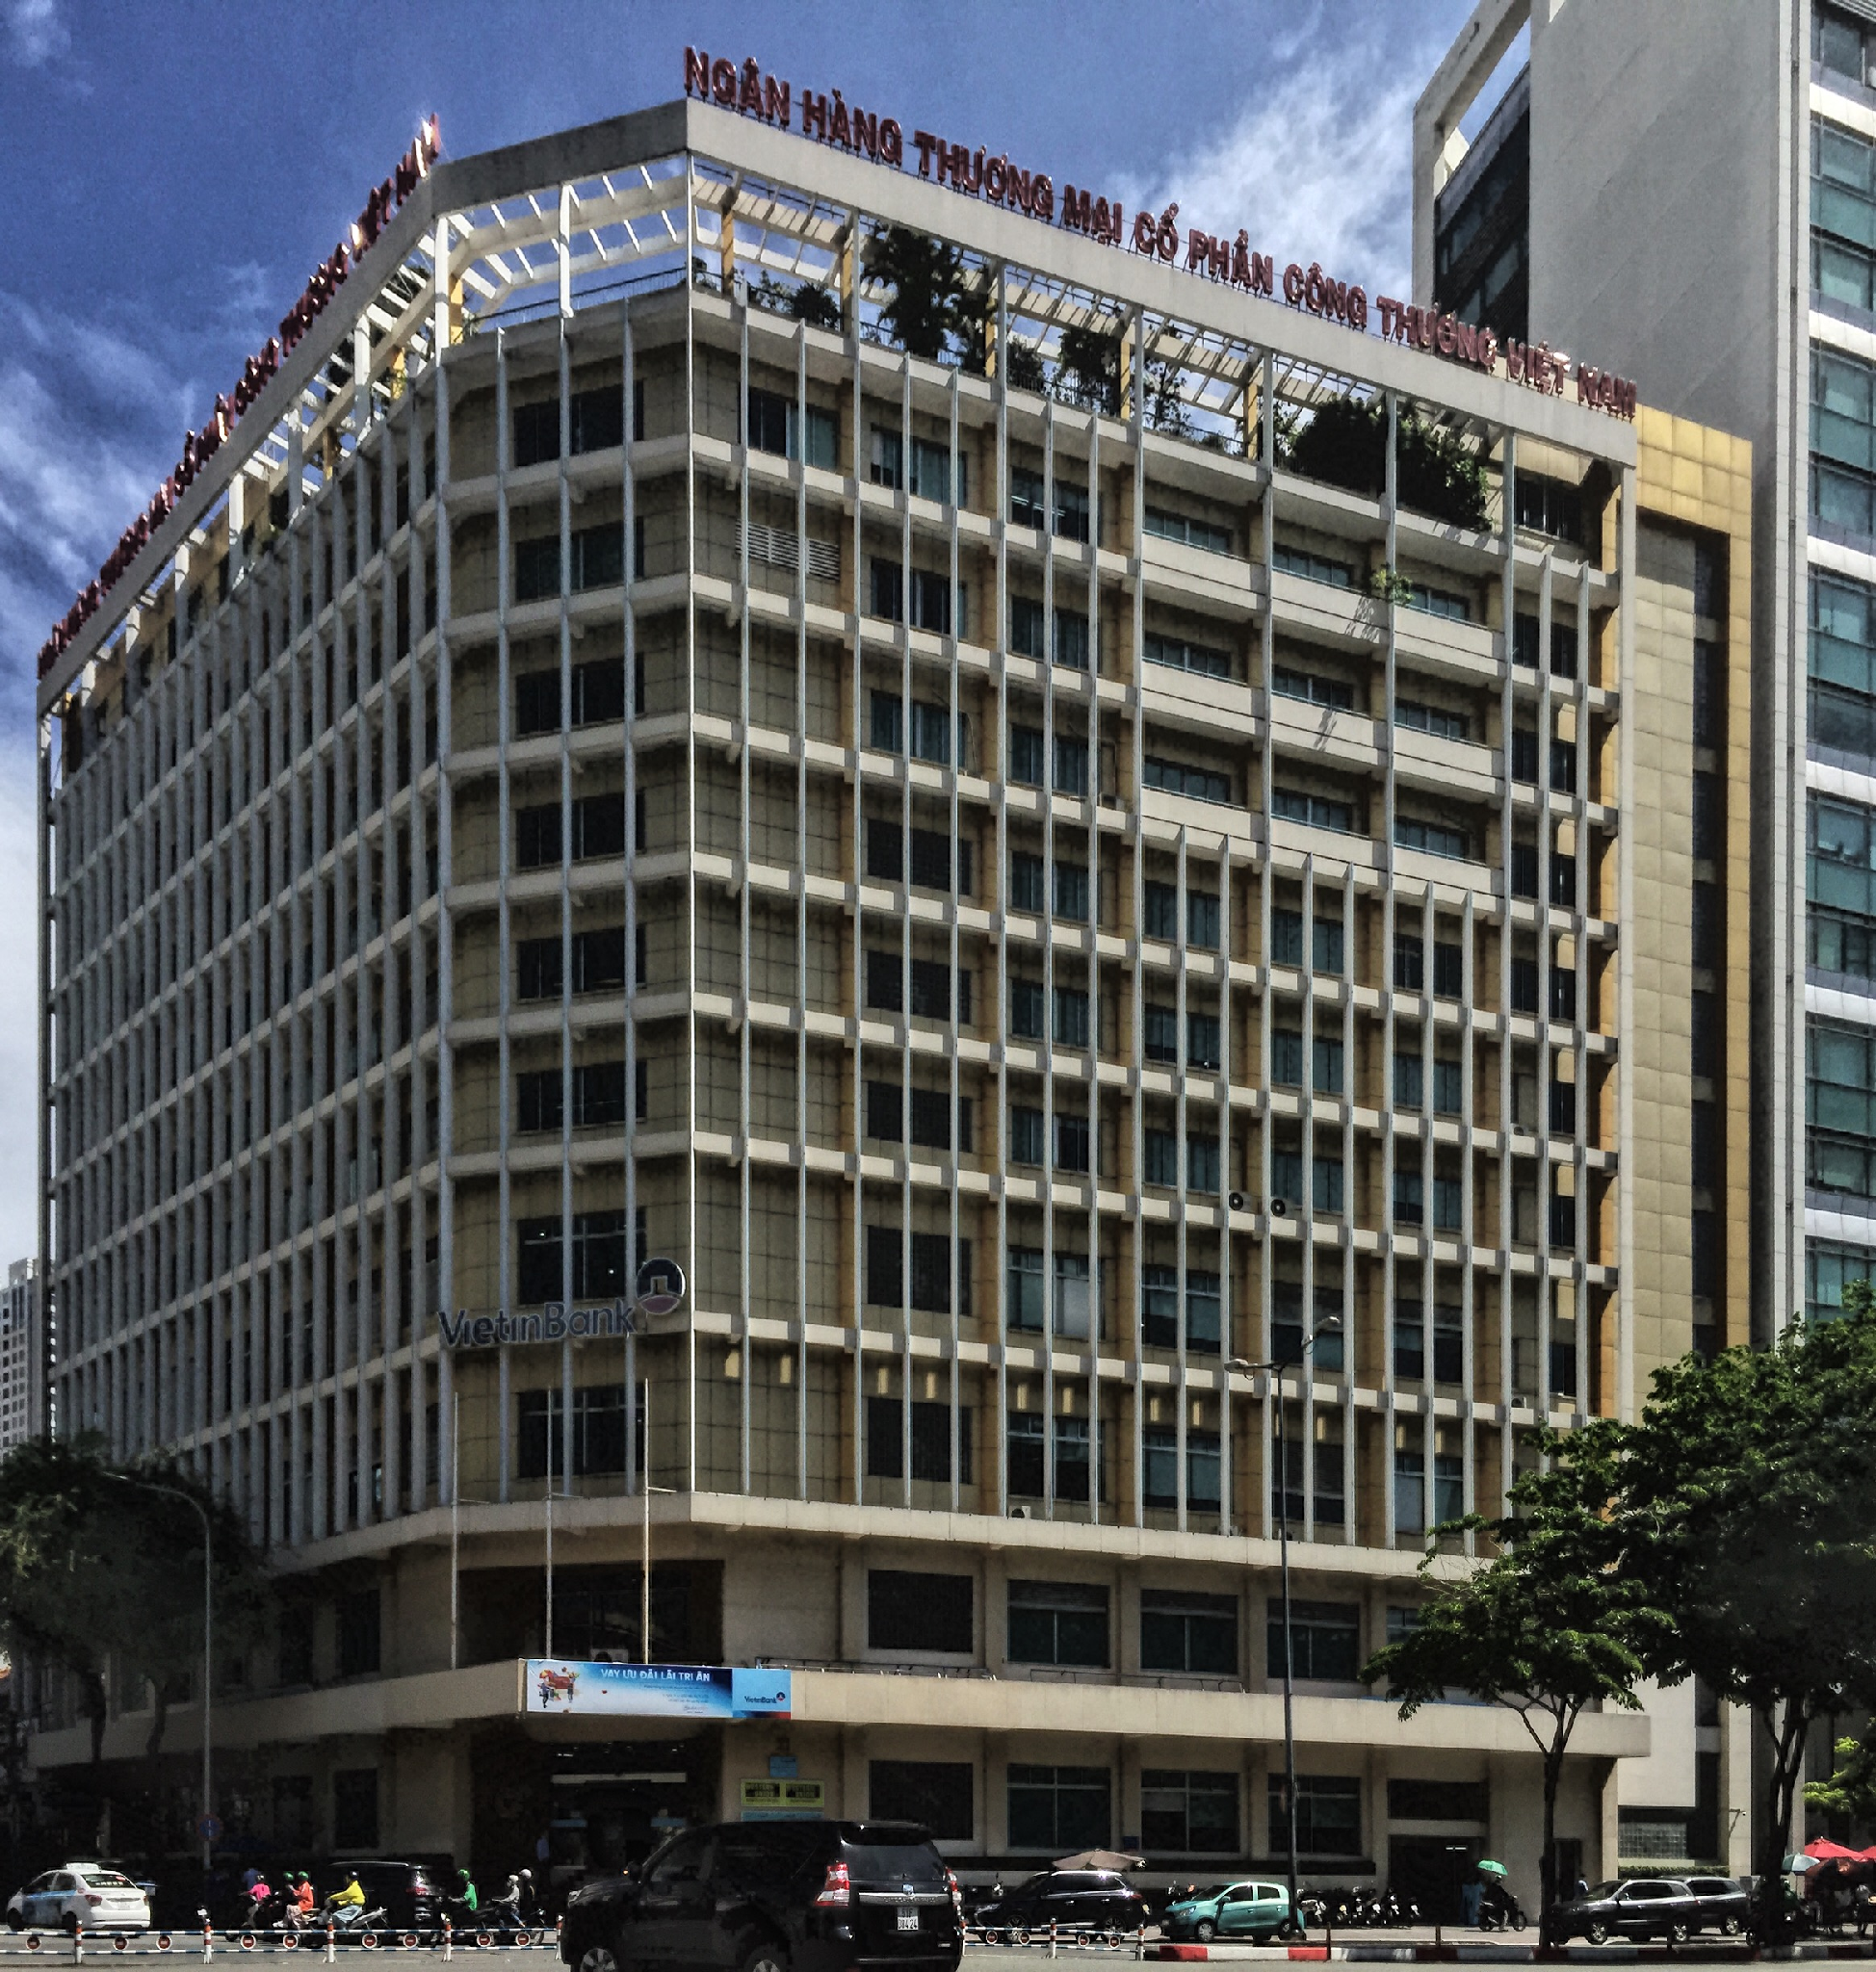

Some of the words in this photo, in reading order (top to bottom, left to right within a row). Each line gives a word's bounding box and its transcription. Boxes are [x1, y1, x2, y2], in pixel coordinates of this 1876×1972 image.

[683, 45, 791, 127] NGÂN
[801, 88, 903, 168] HÀNG
[914, 129, 1055, 221] THƯƠNG
[1063, 184, 1123, 246] MẠI
[1134, 202, 1180, 262] CỔ
[1283, 261, 1368, 329] CÔNG
[1376, 295, 1498, 373] THƯƠNG
[1576, 360, 1638, 420] NAM
[437, 1300, 638, 1347] VietinBank
[600, 1668, 620, 1679] VAY
[677, 1671, 693, 1681] TRI
